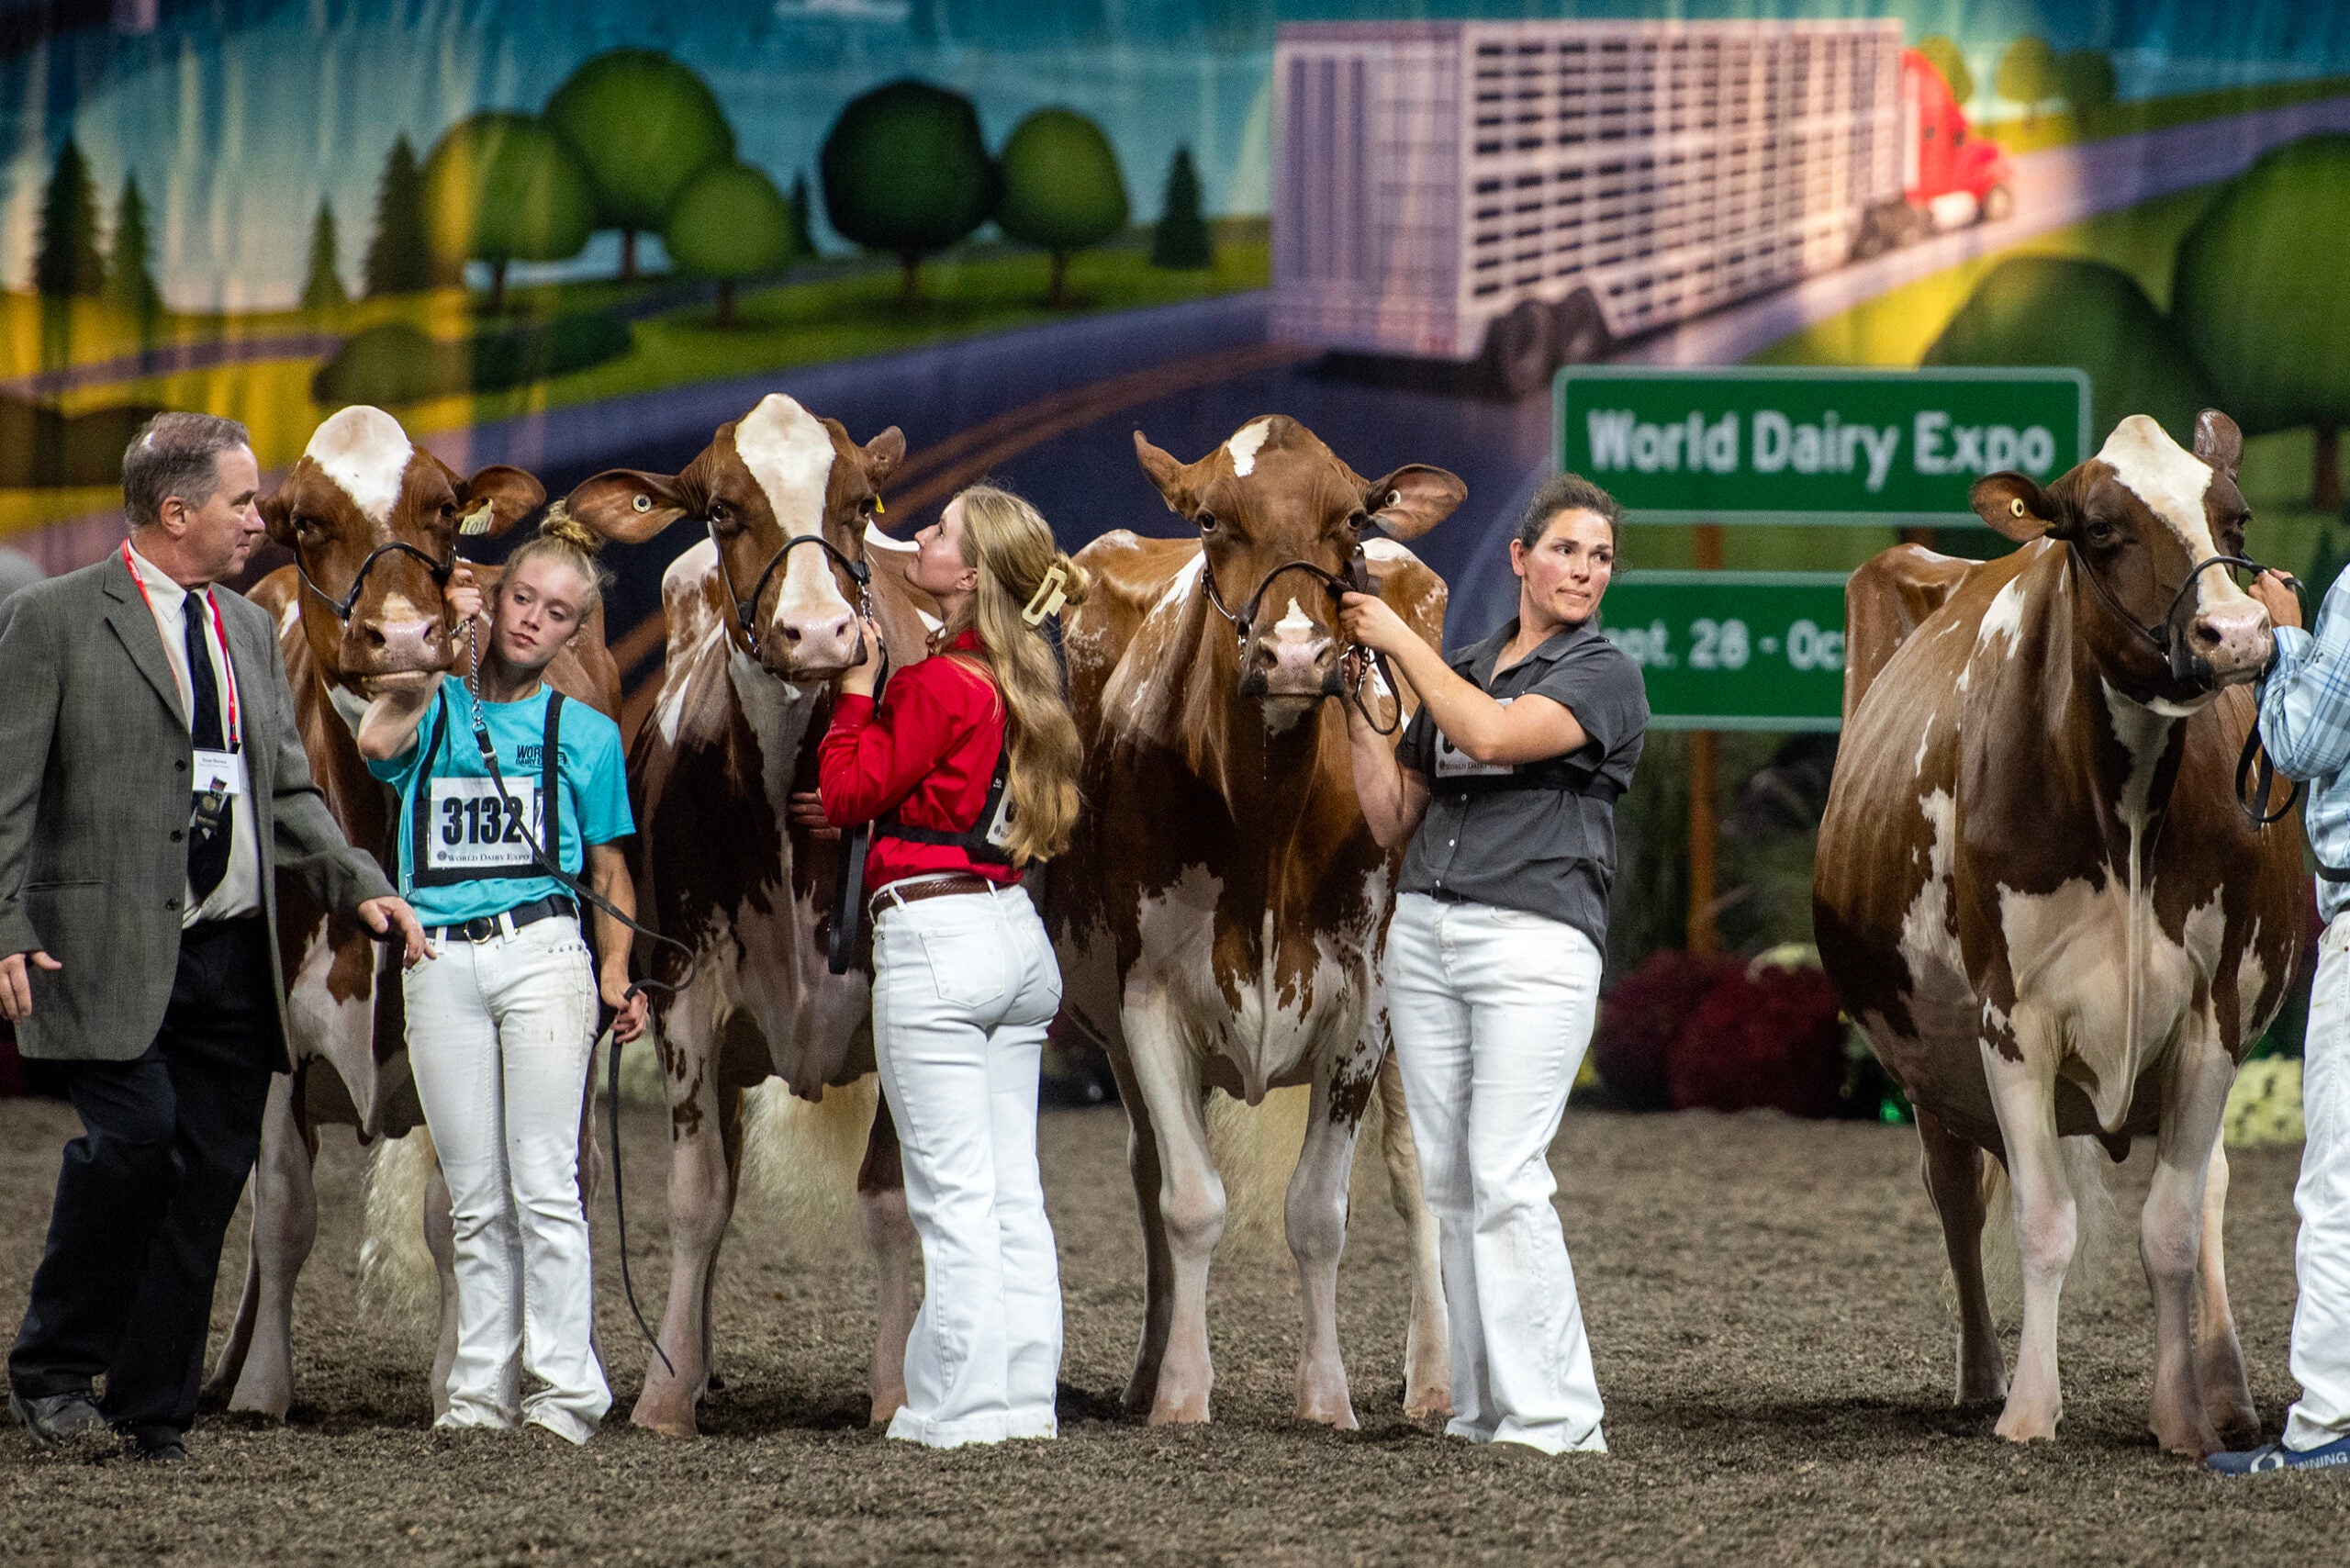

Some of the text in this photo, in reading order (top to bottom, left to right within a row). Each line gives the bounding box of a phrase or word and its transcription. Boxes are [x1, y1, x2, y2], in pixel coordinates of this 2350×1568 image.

[1587, 409, 2054, 491] World Dairy Expo
[1689, 618, 1750, 669] 28
[1786, 619, 1845, 671] Oc
[517, 745, 542, 758] WOR
[442, 796, 523, 845] 3132
[448, 854, 477, 862] WORLD
